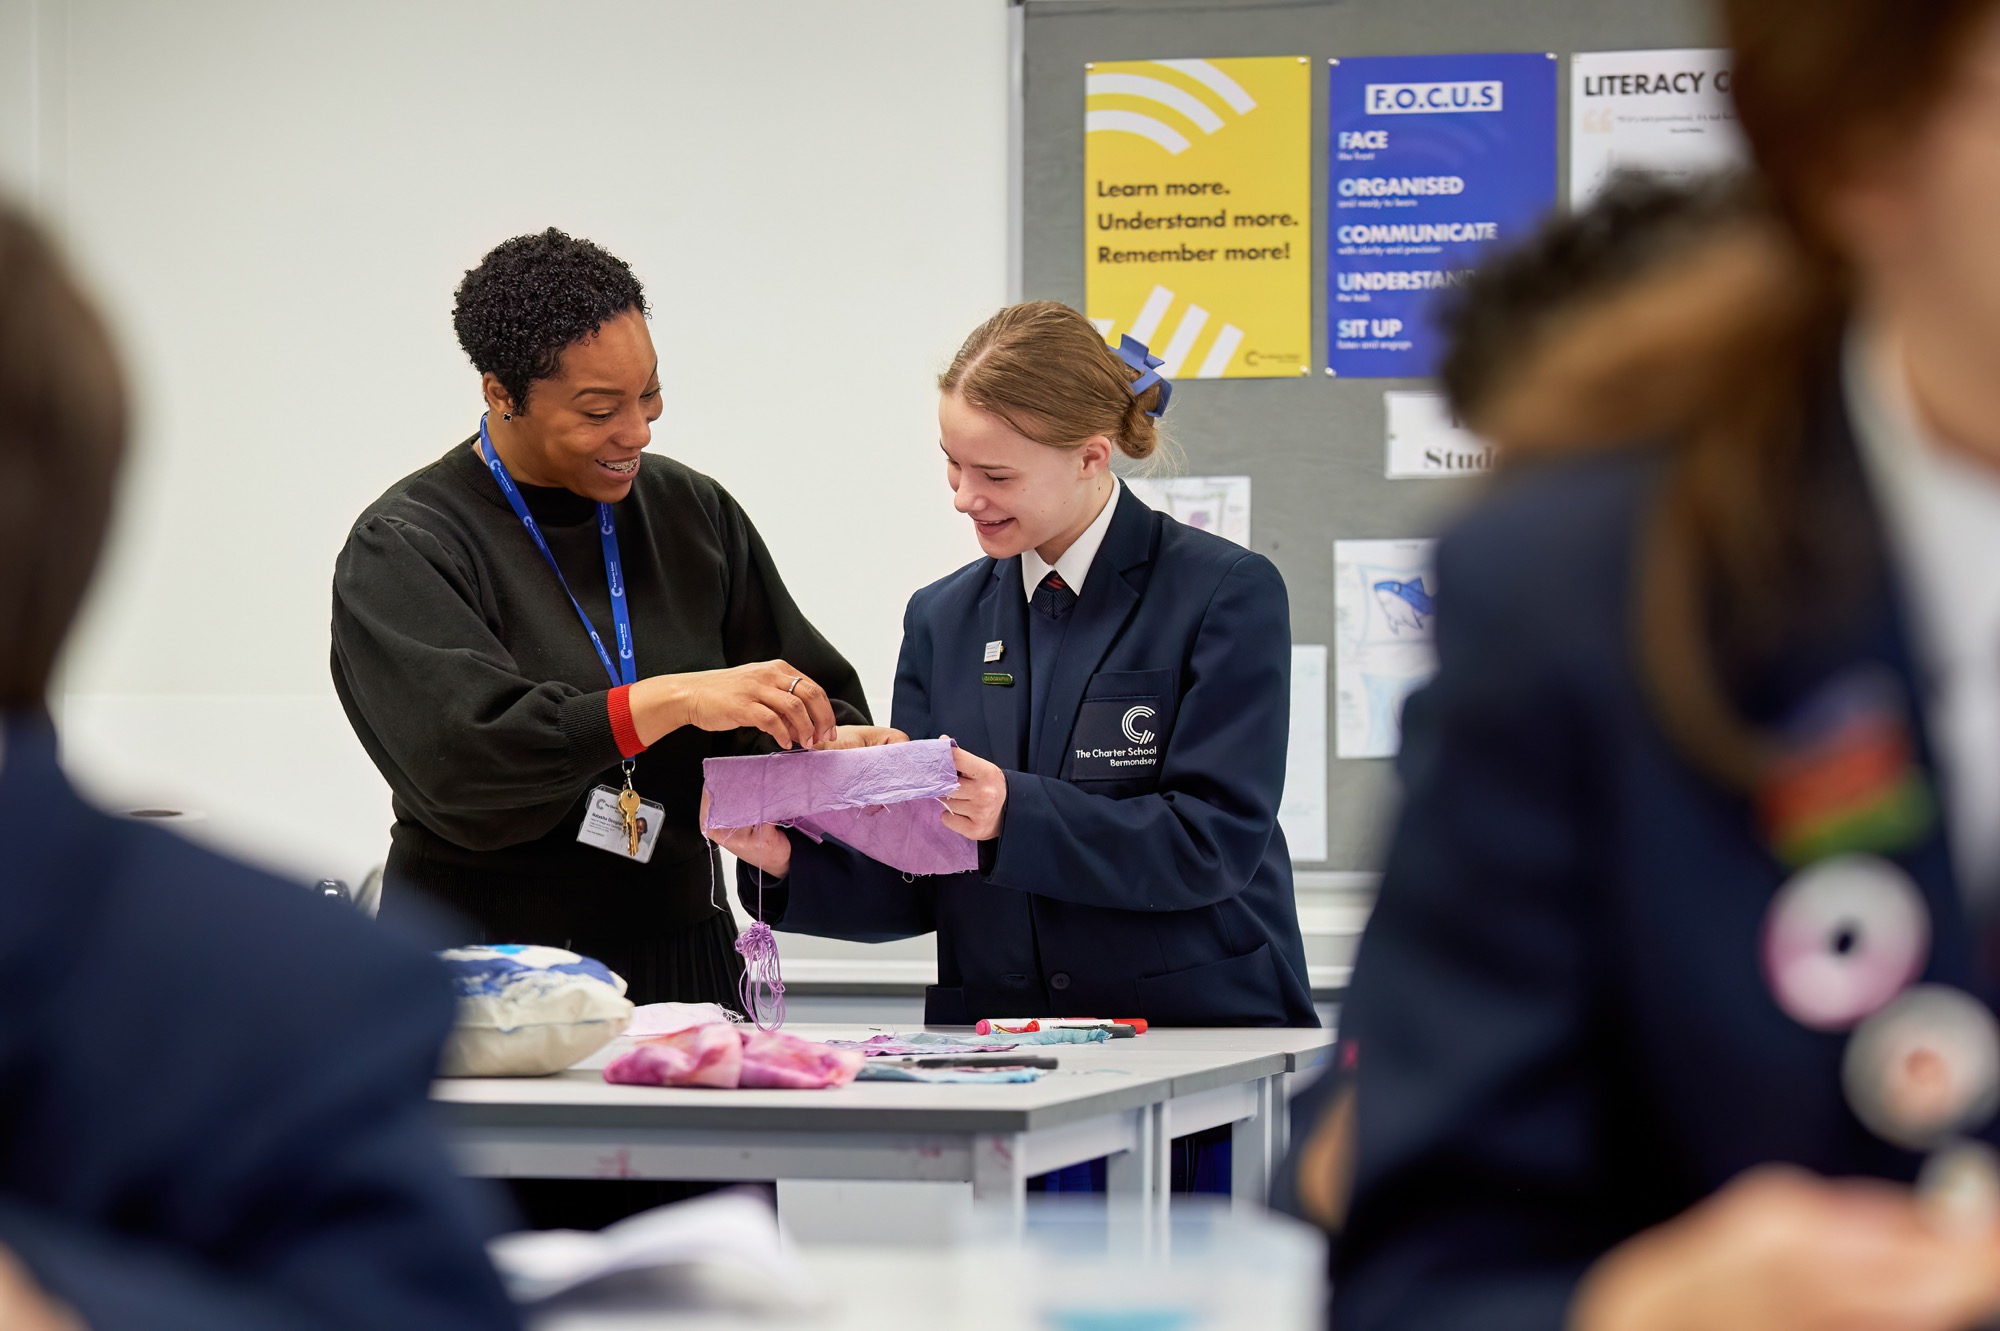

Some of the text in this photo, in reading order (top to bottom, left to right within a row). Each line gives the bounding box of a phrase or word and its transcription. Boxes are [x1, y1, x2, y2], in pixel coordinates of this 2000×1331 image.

[1584, 71, 1704, 96] LITERACY
[1338, 130, 1388, 149] FACE
[1097, 180, 1230, 197] Learn more.
[1337, 176, 1464, 196] ORGANISED
[1098, 210, 1299, 230] Understand more.
[1338, 222, 1498, 244] COMMUNICATE
[1098, 242, 1290, 263] Remember more!
[1338, 318, 1403, 338] SIT UP
[1424, 446, 1494, 469] Stud
[1076, 746, 1156, 758] The Charter School
[1110, 758, 1156, 766] Bermondsey
